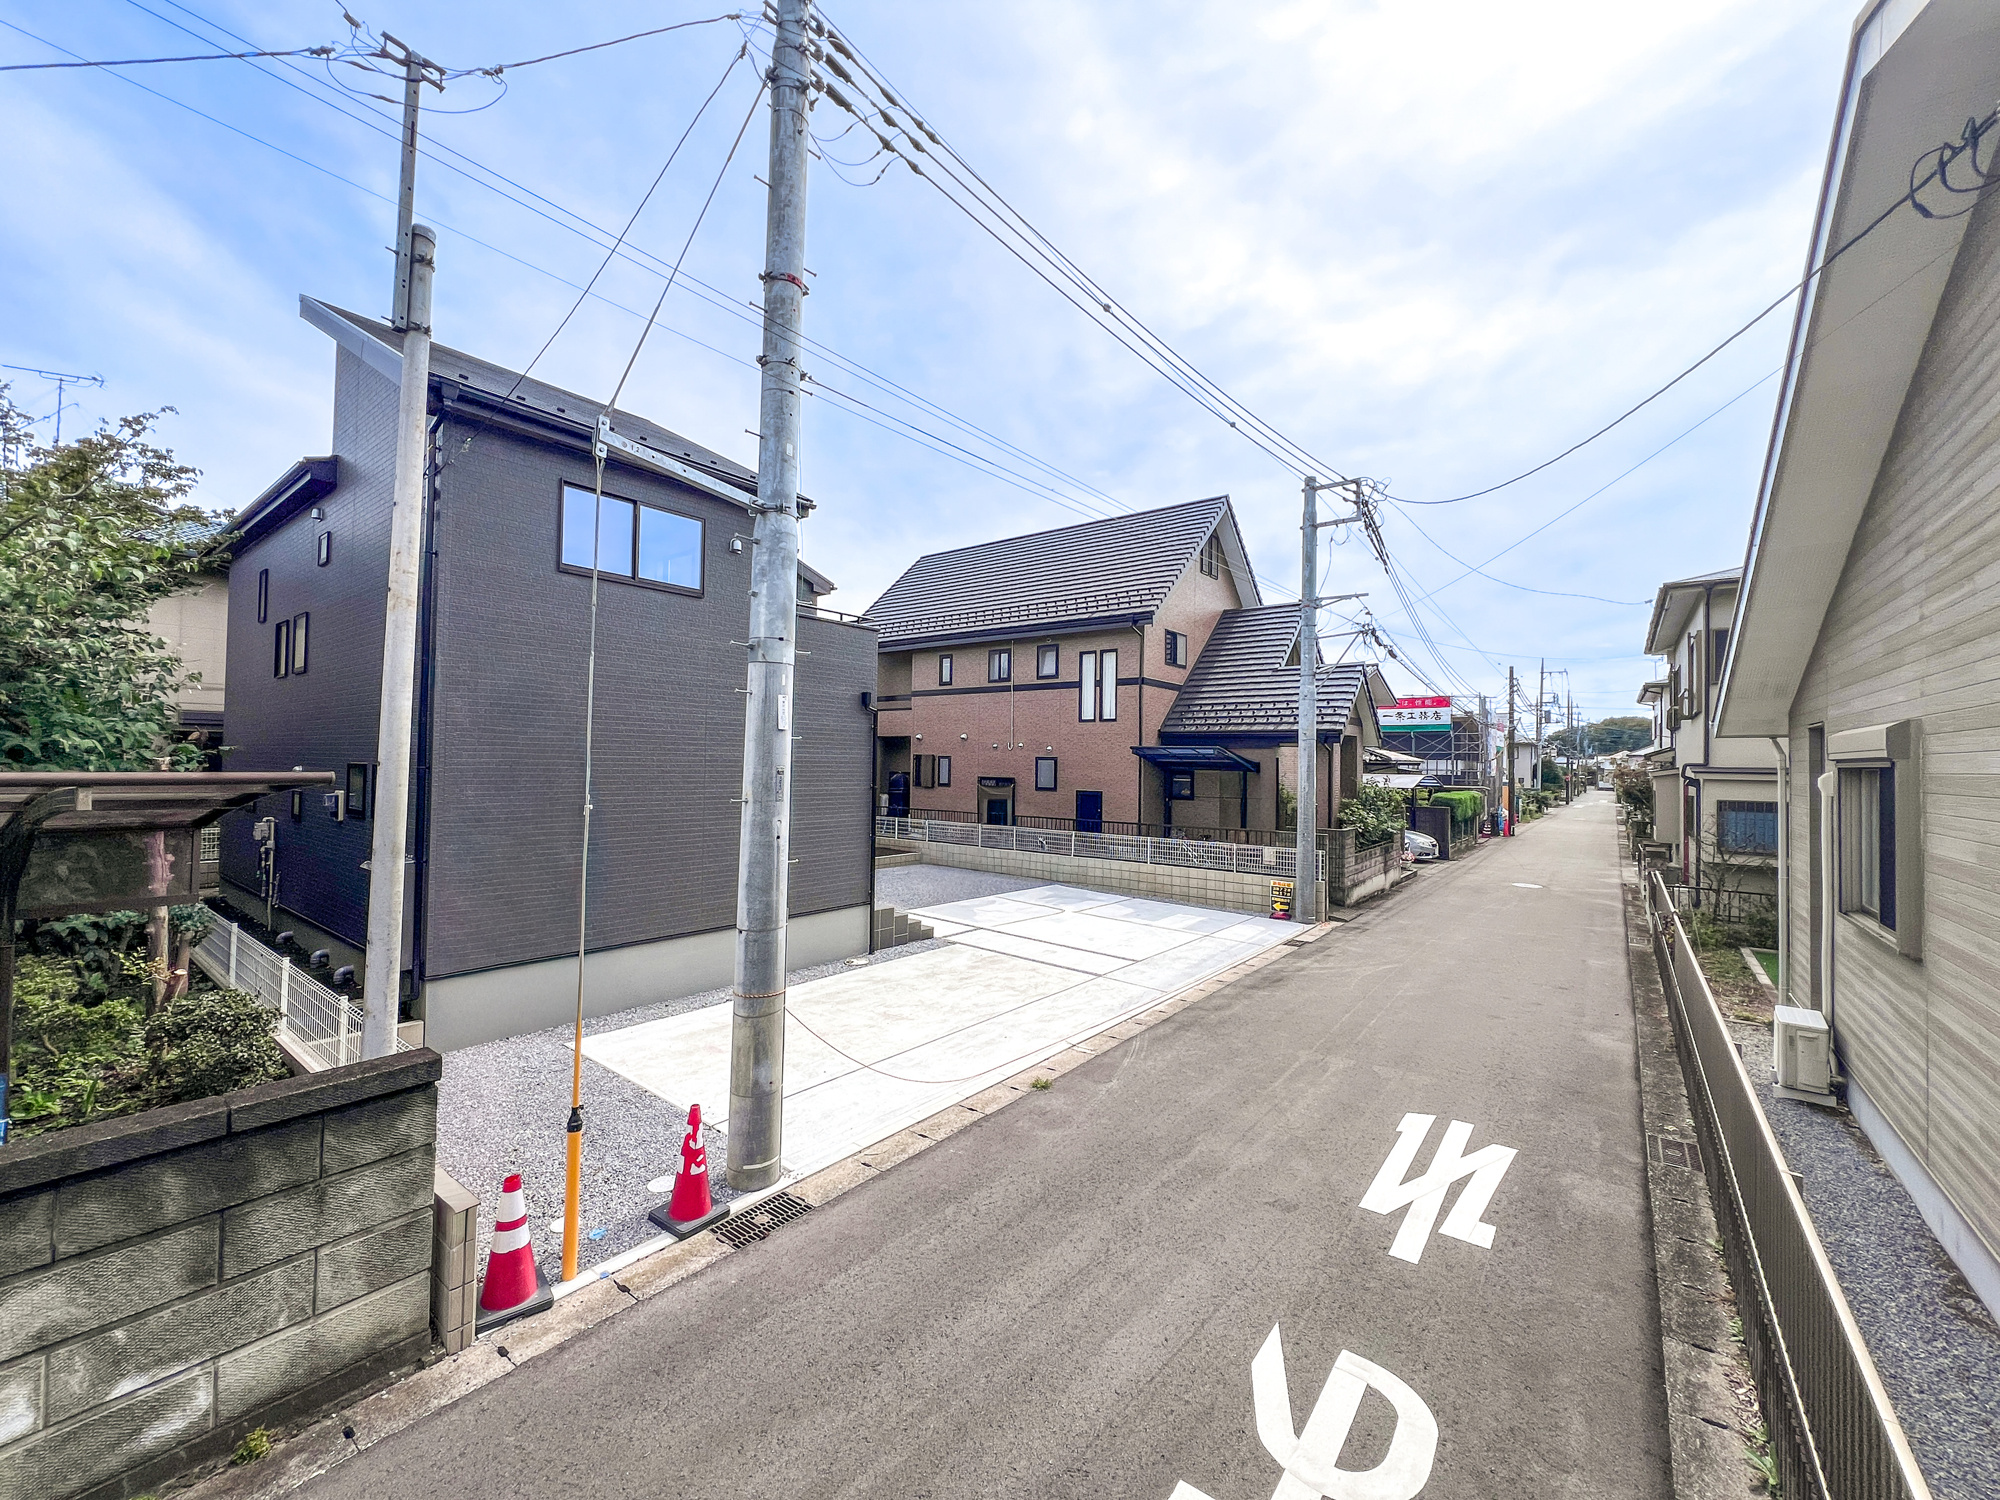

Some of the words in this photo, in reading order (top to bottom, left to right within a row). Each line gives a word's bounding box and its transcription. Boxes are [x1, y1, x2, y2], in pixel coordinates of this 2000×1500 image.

[1382, 710, 1444, 722] 一条工務店
